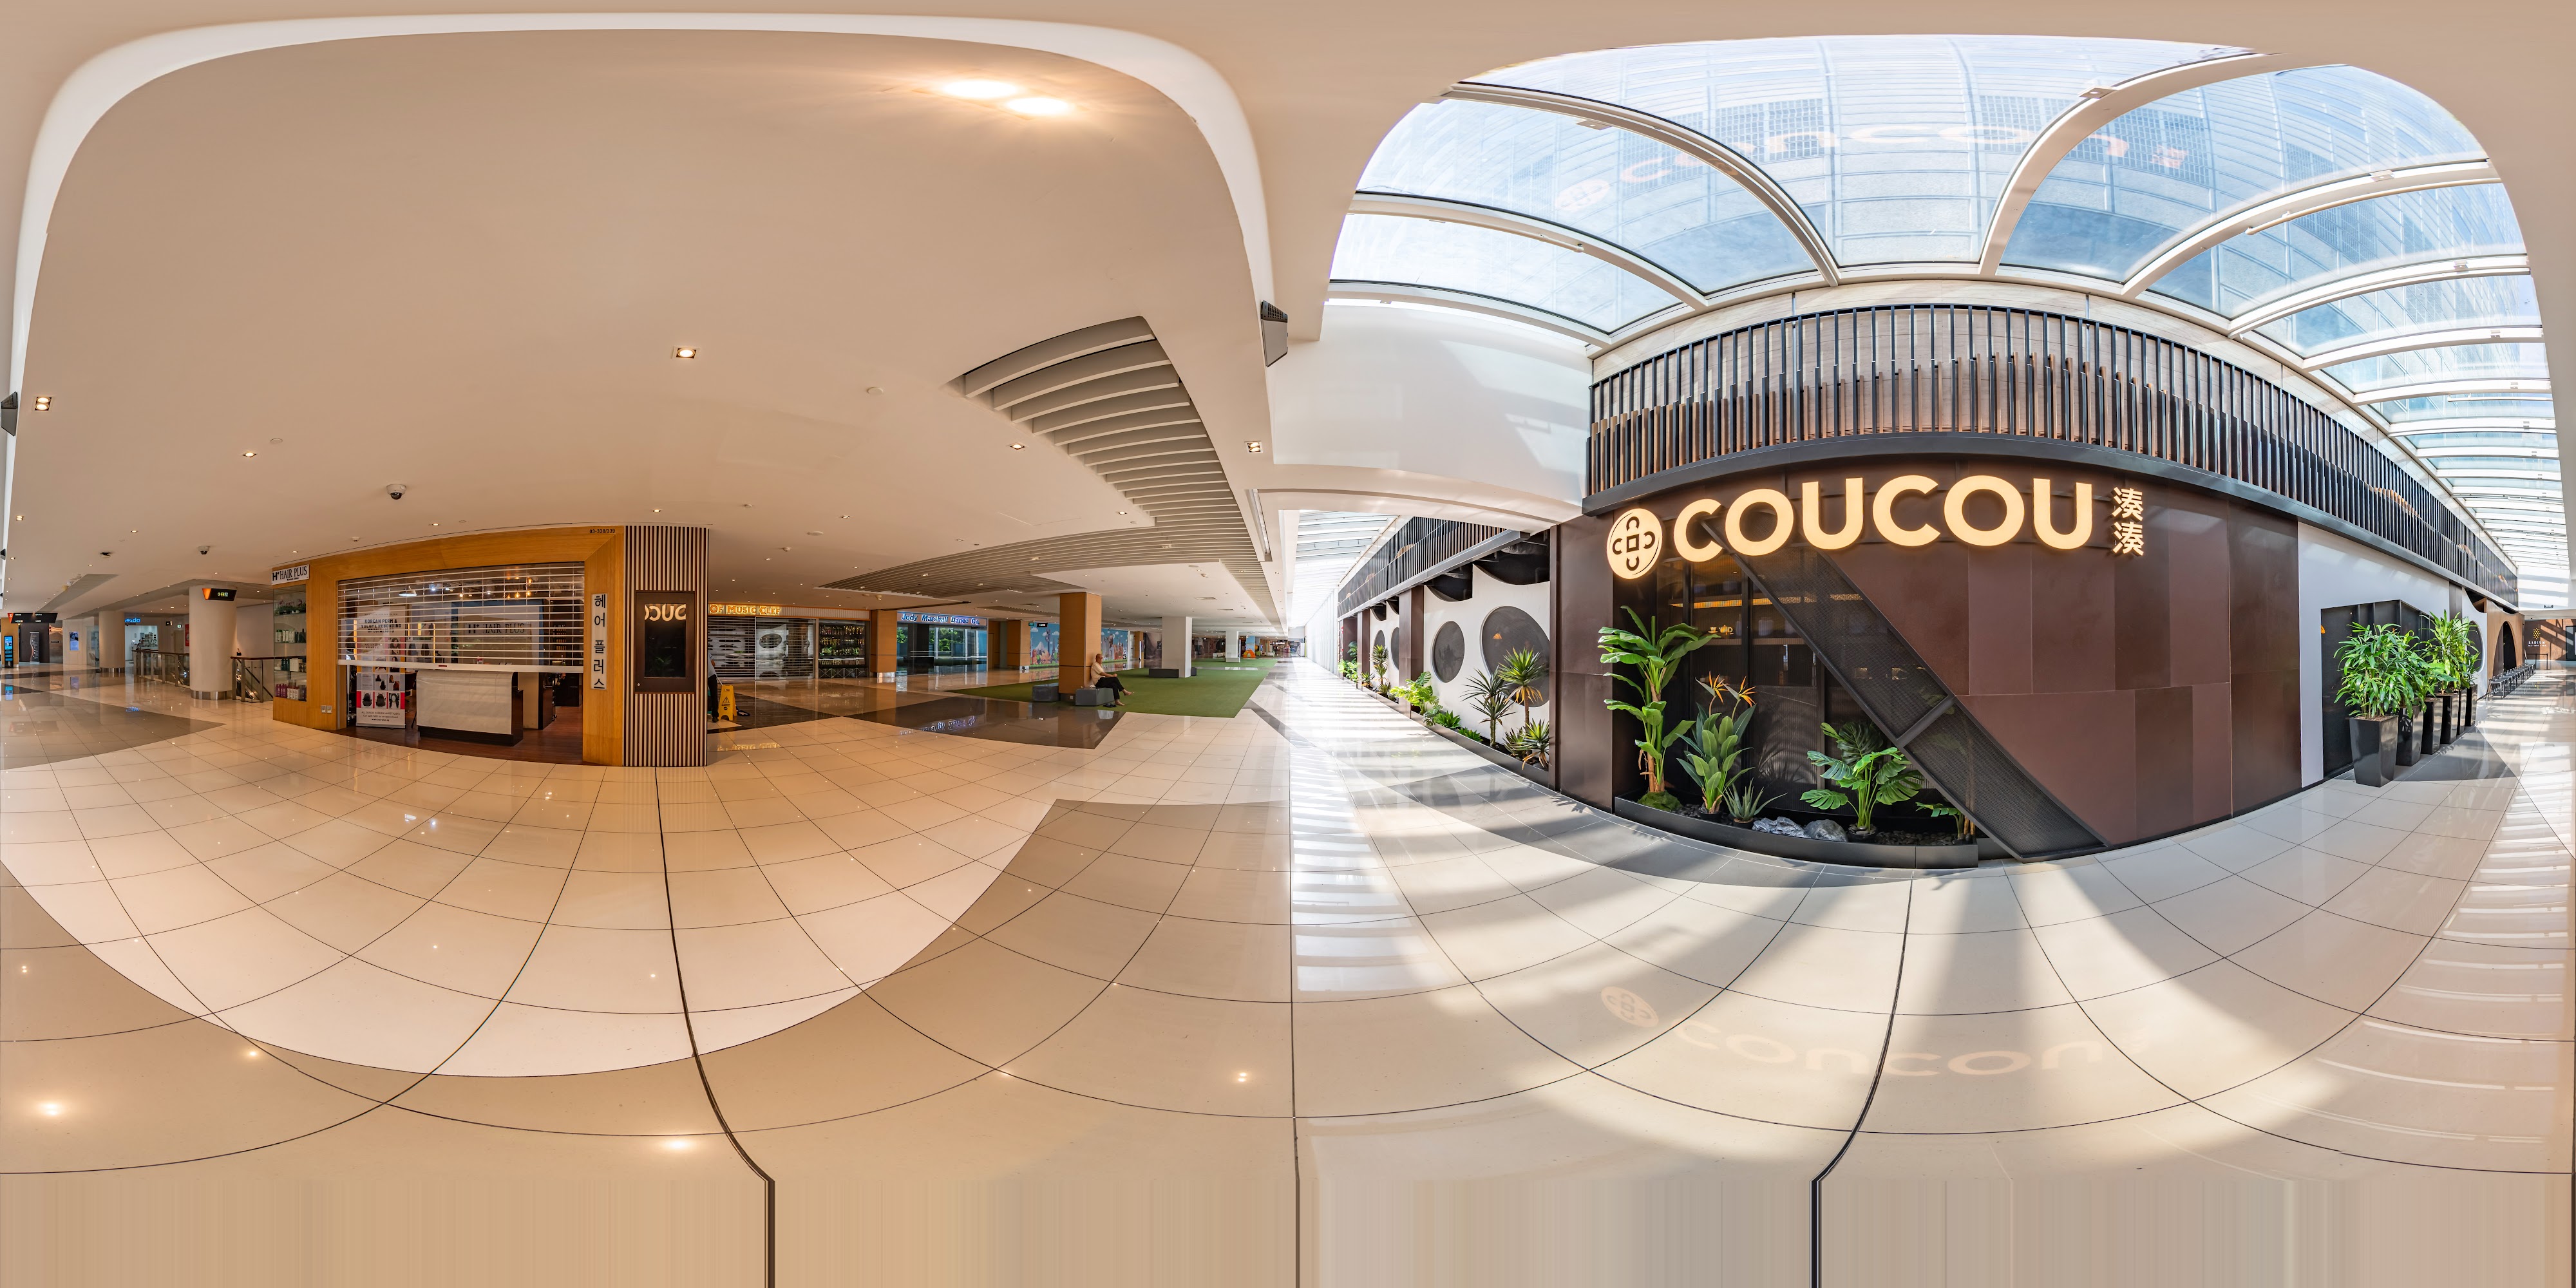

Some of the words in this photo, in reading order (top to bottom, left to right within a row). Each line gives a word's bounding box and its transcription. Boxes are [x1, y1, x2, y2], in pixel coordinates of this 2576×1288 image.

[1674, 475, 2092, 563] COUCOU
[2112, 486, 2145, 556] 湊湊
[279, 569, 292, 579] HAIR
[294, 566, 307, 577] PLUS
[594, 594, 606, 627] 헤어
[902, 613, 918, 621] Jody
[921, 614, 948, 623] Marshall
[505, 623, 524, 634] PLUS
[594, 639, 605, 689] 플러스
